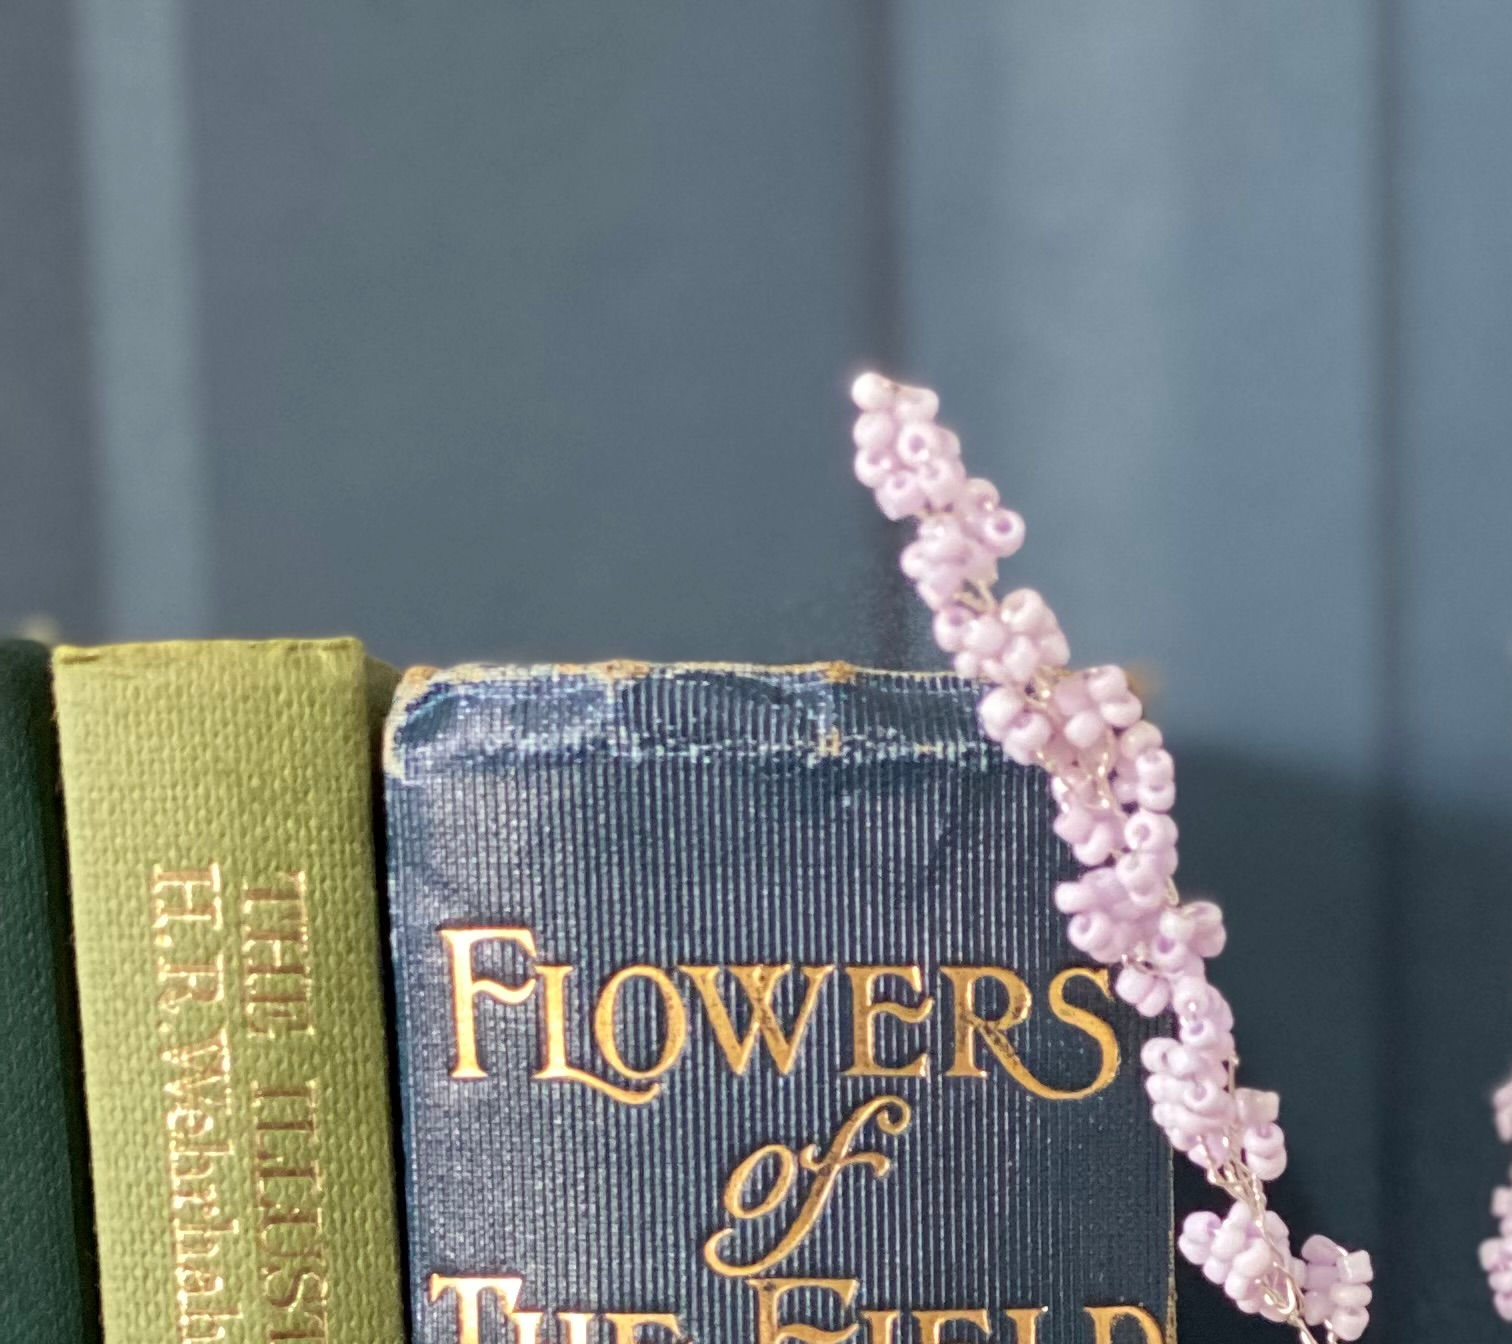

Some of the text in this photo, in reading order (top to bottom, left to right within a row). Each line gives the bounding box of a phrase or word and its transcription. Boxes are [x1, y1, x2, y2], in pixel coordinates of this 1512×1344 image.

[240, 870, 315, 1040] THE
[440, 927, 1121, 1104] FLOWERS
[702, 1095, 912, 1278] of
